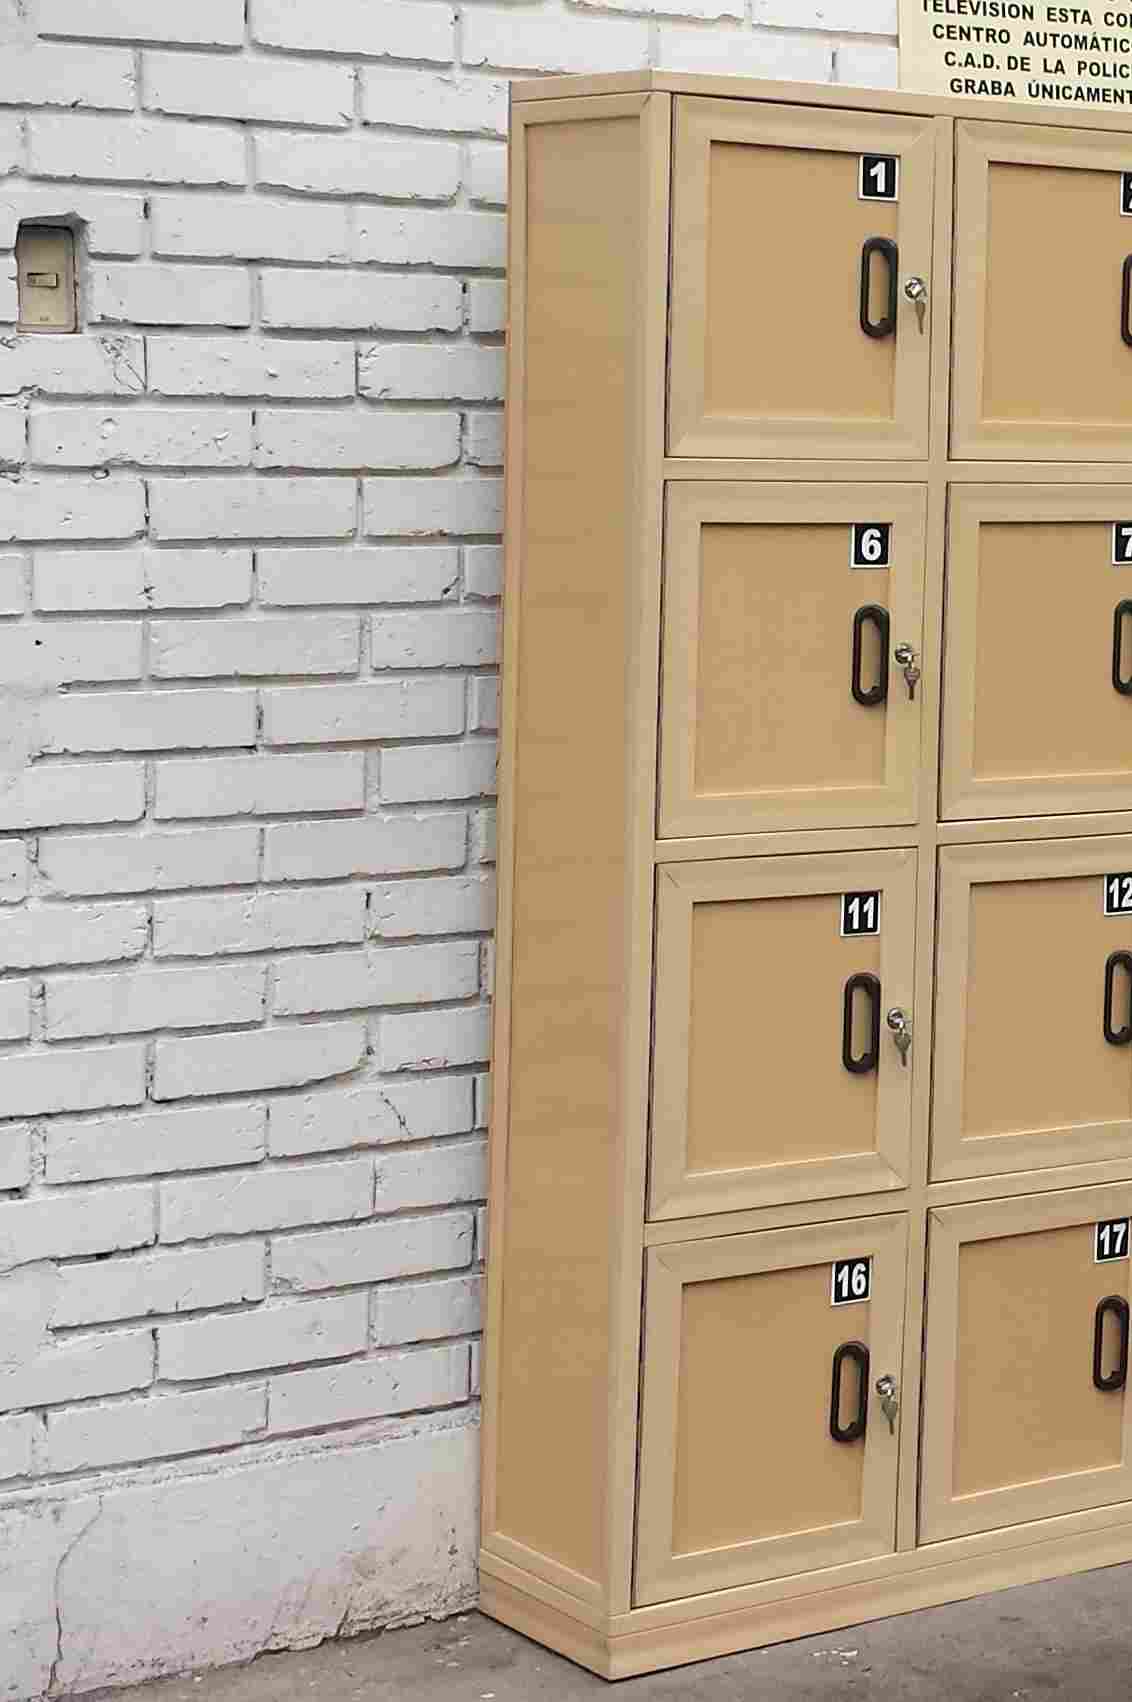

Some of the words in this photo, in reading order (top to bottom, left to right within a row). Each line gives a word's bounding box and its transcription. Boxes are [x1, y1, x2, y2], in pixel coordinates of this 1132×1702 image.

[923, 0, 1034, 21] TELEVISION
[1046, 6, 1092, 26] ESTA
[932, 23, 1011, 45] CENTRO
[944, 51, 1000, 70] C.A.D.
[1007, 55, 1031, 72] DE
[1043, 57, 1066, 75] LA
[949, 78, 1016, 97] GRABA
[870, 162, 885, 192] 1
[862, 529, 881, 560] 6
[848, 897, 874, 929] 11
[1100, 1222, 1127, 1256] 17
[838, 1264, 866, 1297] 16
